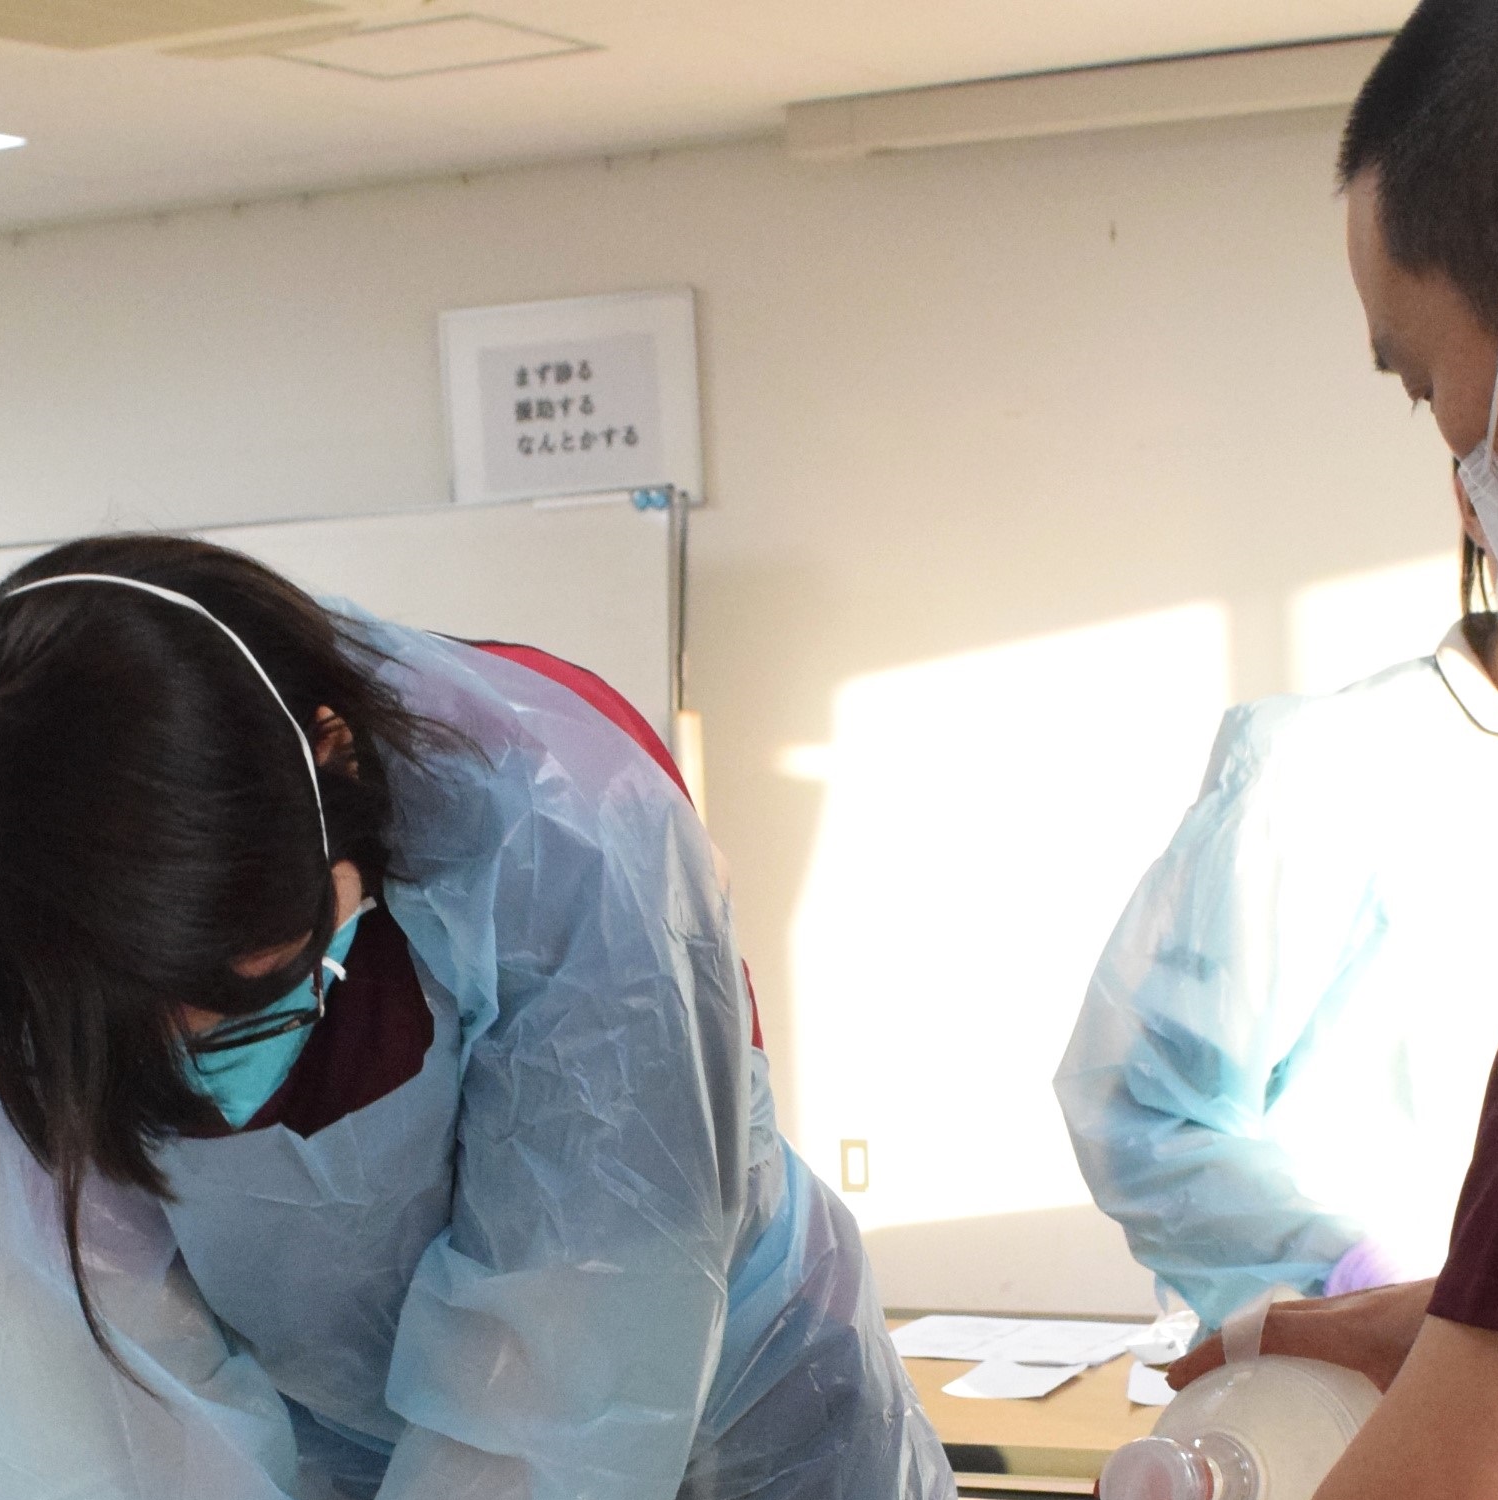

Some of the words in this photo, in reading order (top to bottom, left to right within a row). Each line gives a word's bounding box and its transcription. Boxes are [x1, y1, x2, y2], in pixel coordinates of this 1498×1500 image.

[518, 425, 640, 455] なんとかする
